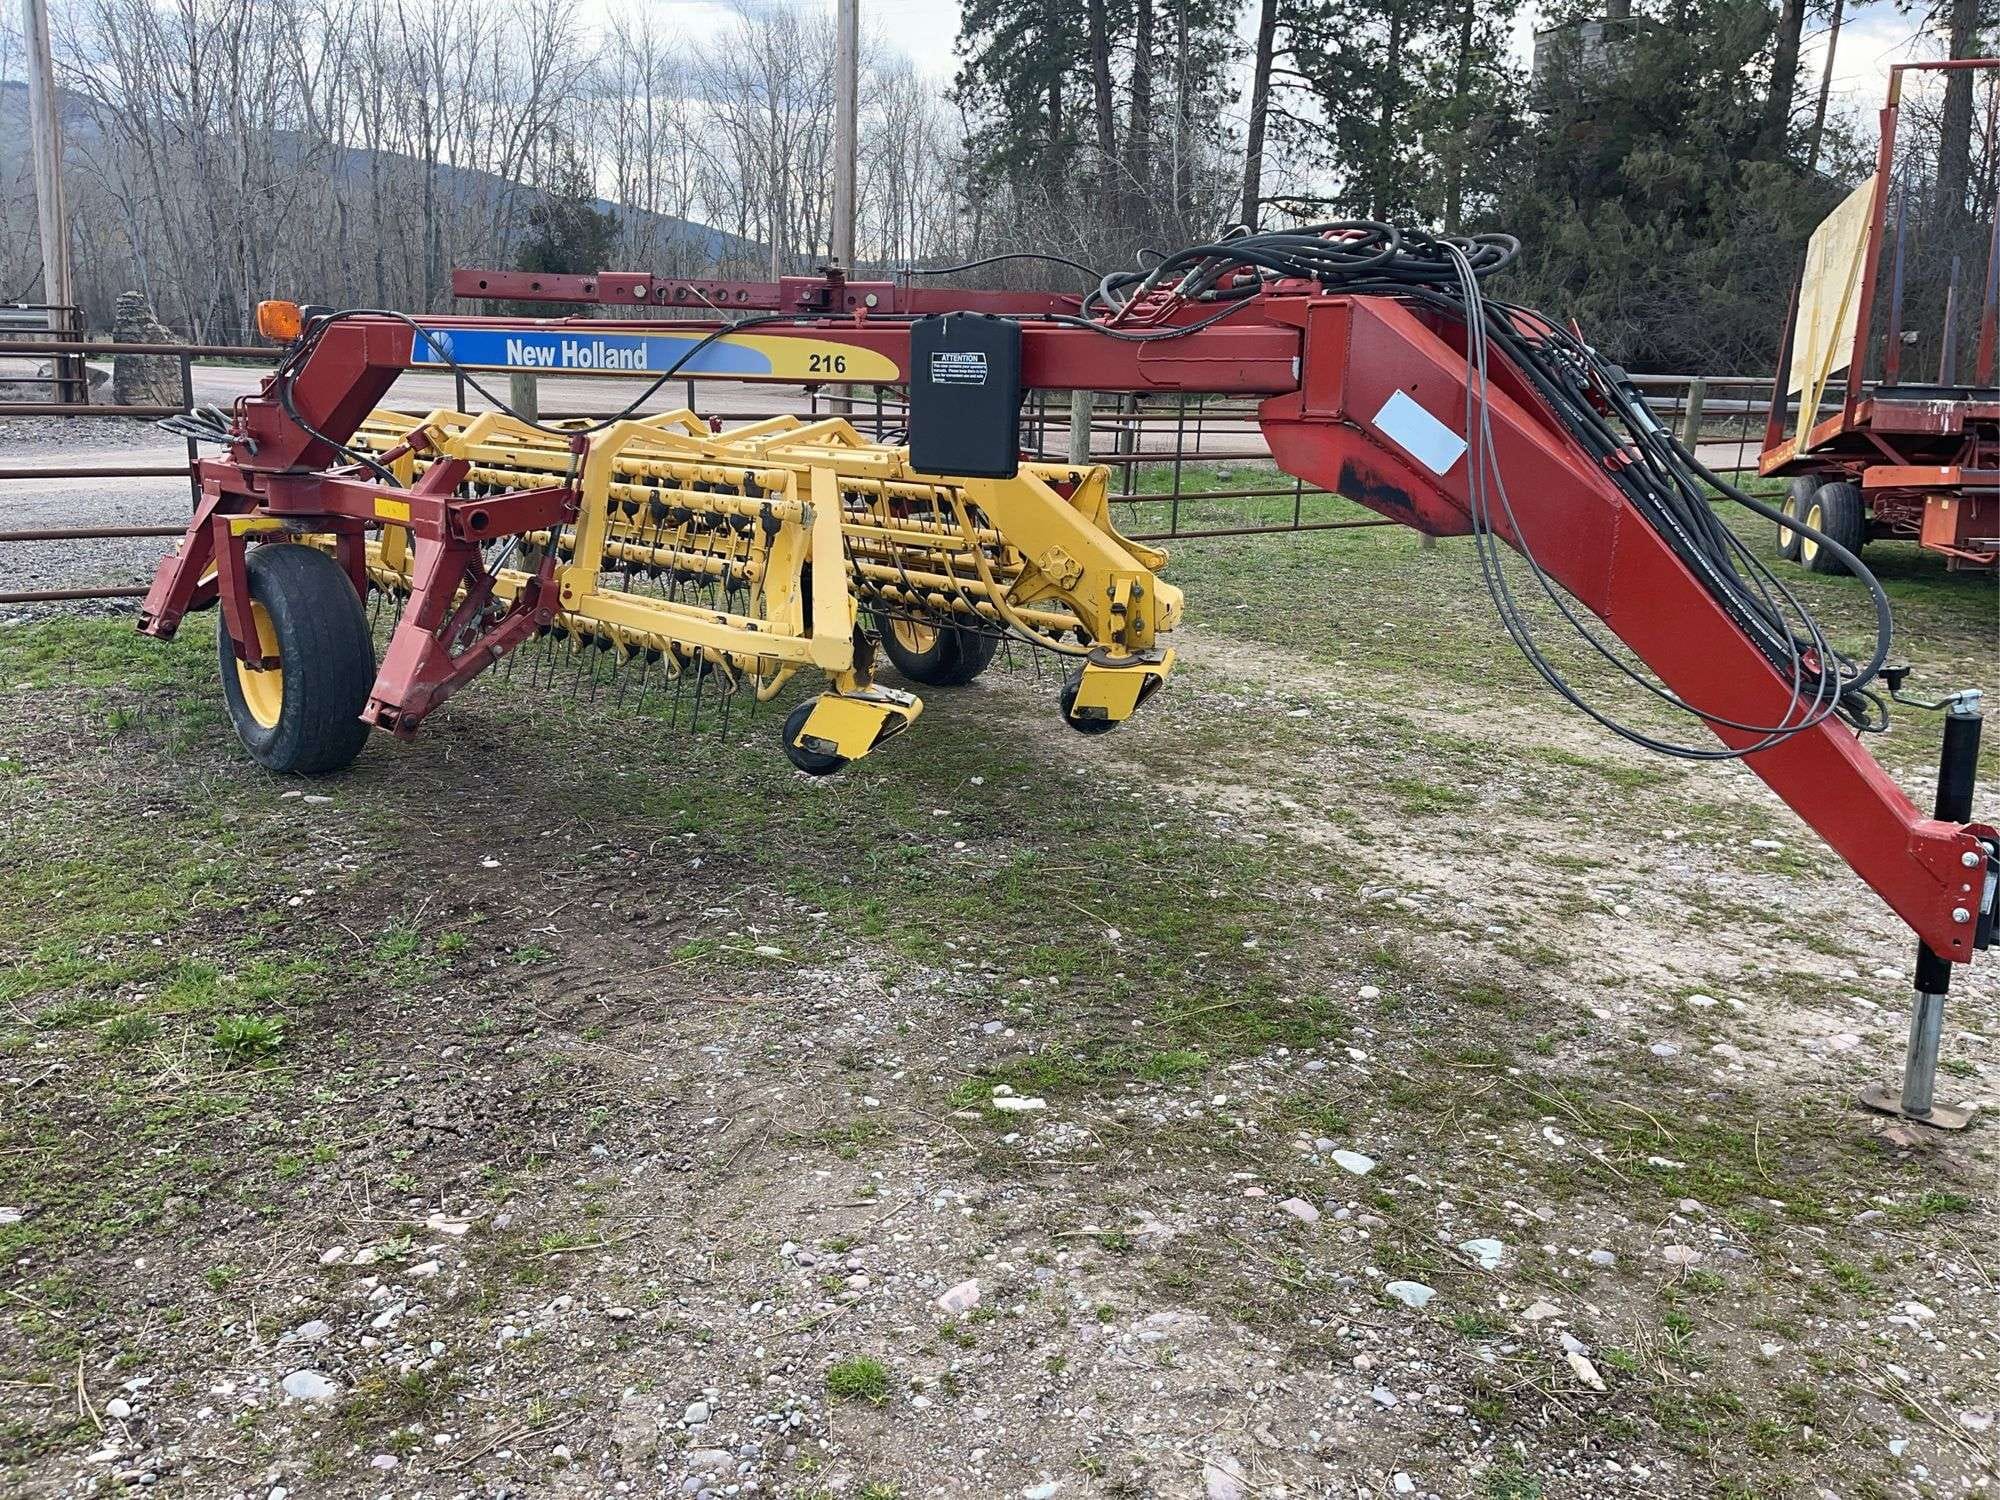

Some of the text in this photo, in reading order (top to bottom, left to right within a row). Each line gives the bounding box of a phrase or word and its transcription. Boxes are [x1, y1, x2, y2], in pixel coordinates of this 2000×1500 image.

[507, 339, 647, 370] New Holland
[809, 354, 846, 373] 216
[941, 354, 978, 362] ATTENTION
